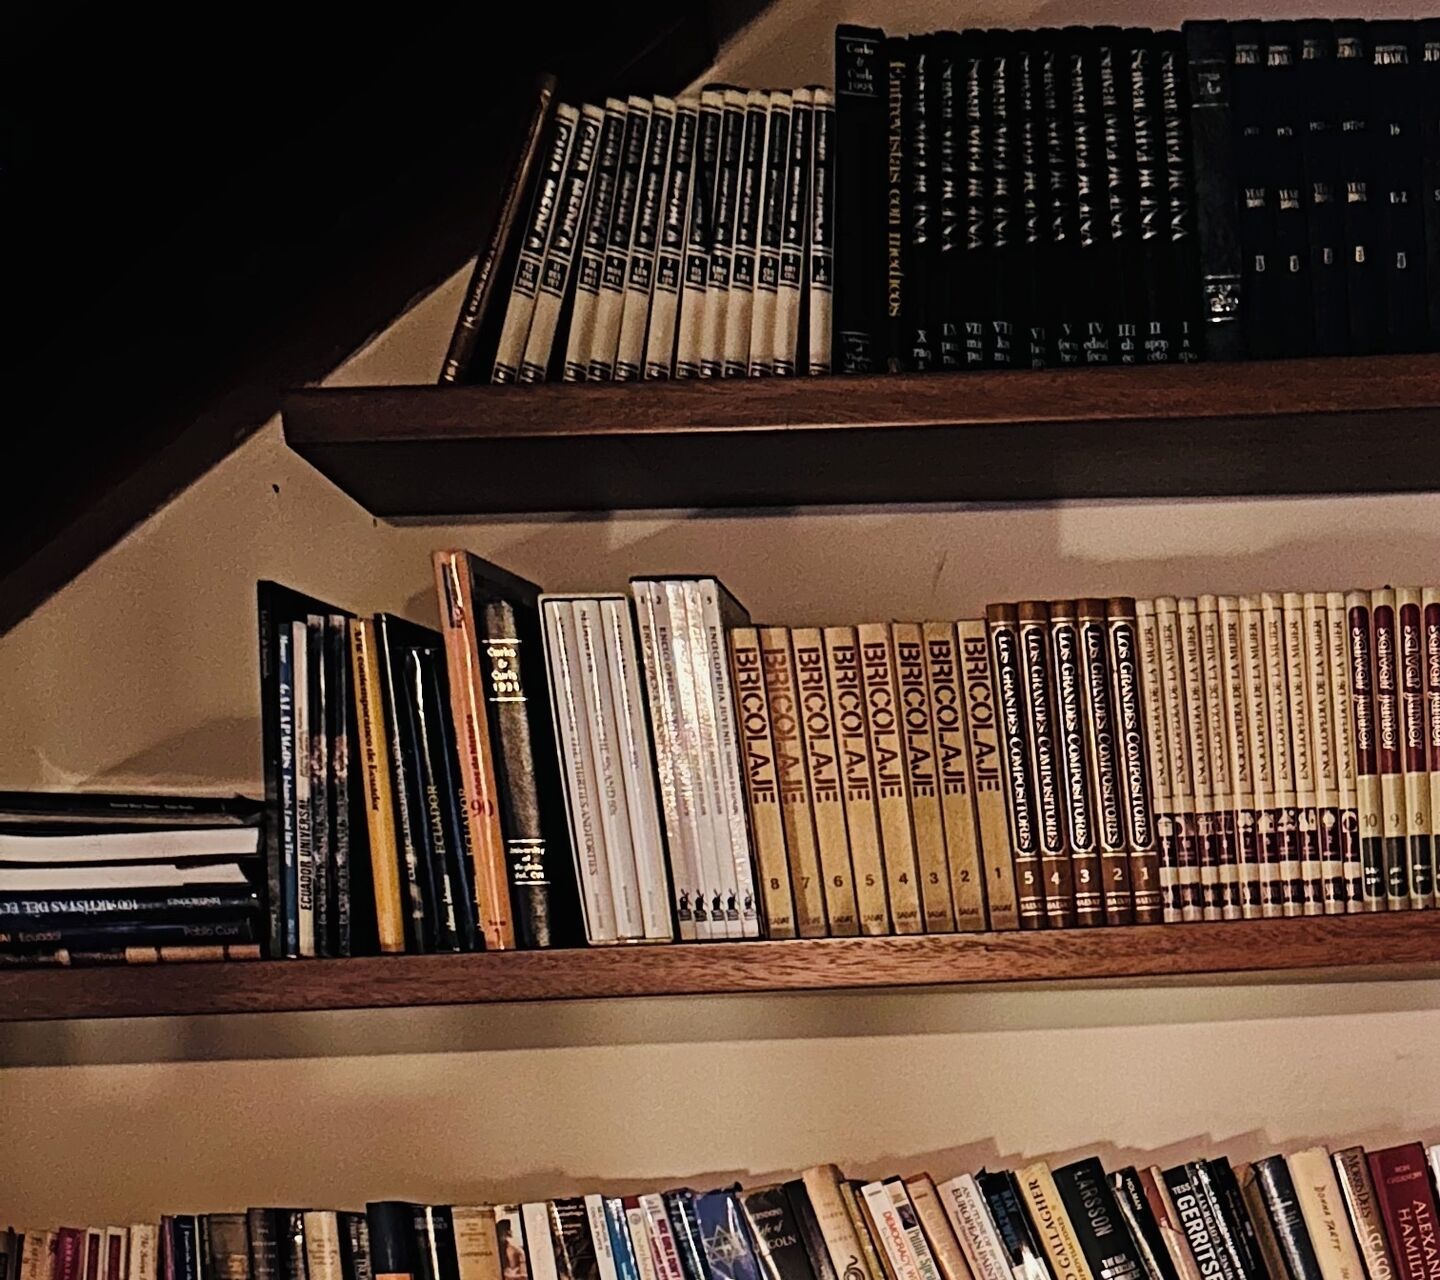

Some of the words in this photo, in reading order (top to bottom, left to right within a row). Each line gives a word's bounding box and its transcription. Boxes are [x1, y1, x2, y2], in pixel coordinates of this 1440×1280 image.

[887, 187, 901, 226] con
[1333, 620, 1344, 658] MUJER
[352, 627, 364, 654] Arte
[365, 747, 375, 762] de
[735, 647, 776, 805] BRICOLAJE
[797, 647, 838, 803] BRICOLAJE
[863, 642, 903, 798] BRICOLAJE
[928, 639, 967, 795] BRICOLAJE
[1000, 664, 1022, 735] GRANDES
[1118, 660, 1139, 730] GRANDES
[1008, 735, 1035, 849] COMPOSITORES
[1124, 730, 1150, 844] COMPOSITORES
[297, 796, 311, 857] UNIVERSAL
[425, 784, 446, 854] ECUADOR
[299, 859, 312, 911] ECUADOR
[769, 875, 780, 891] 8
[864, 874, 875, 887] 5
[960, 869, 970, 882] 2
[1023, 871, 1034, 885] 5
[950, 1185, 984, 1251] EUROPEAN
[965, 1197, 987, 1236] OUTLINE
[1026, 1177, 1072, 1271] GALLAGHER
[1072, 1165, 1114, 1238] LARSSON
[1124, 1176, 1143, 1211] HOLMAN
[661, 1234, 675, 1257] GIRLS
[666, 1255, 681, 1279] DON'T
[880, 1209, 913, 1267] DEMOCRACY
